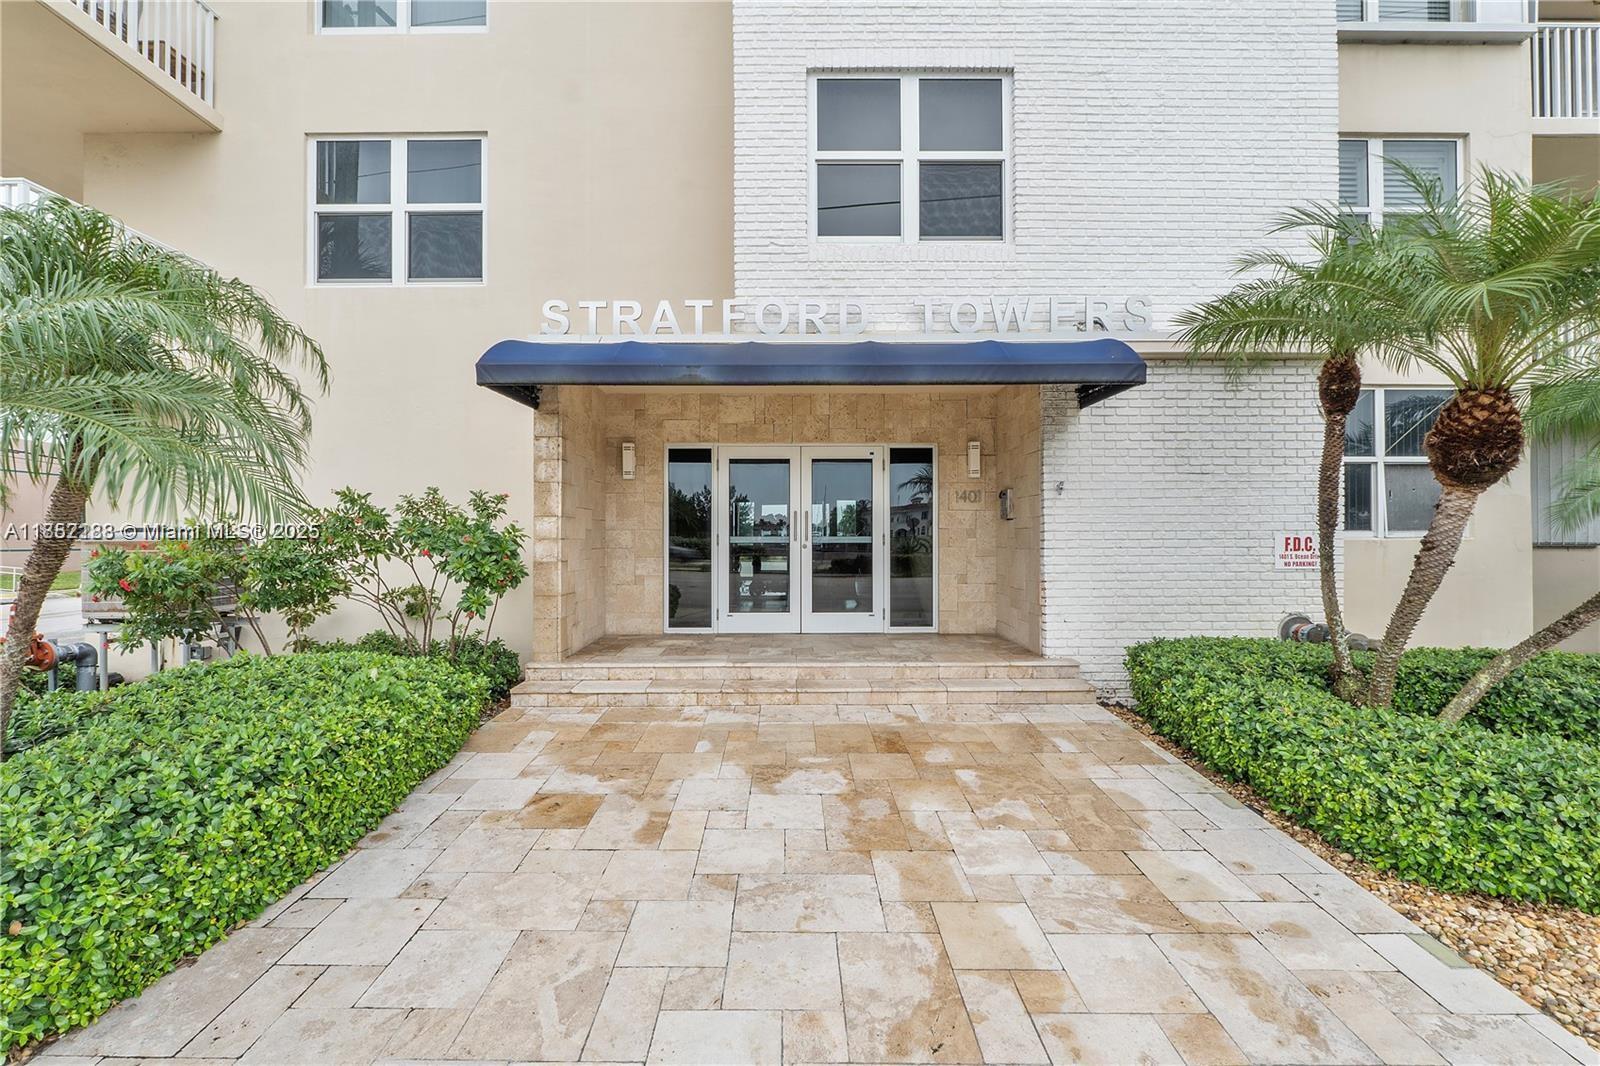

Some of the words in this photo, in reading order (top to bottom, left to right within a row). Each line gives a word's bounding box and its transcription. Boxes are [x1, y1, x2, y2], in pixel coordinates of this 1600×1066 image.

[540, 299, 868, 335] STRATFORD
[914, 296, 1152, 333] TOWERS
[955, 489, 982, 504] 1401
[1284, 536, 1316, 552] F.D.C.
